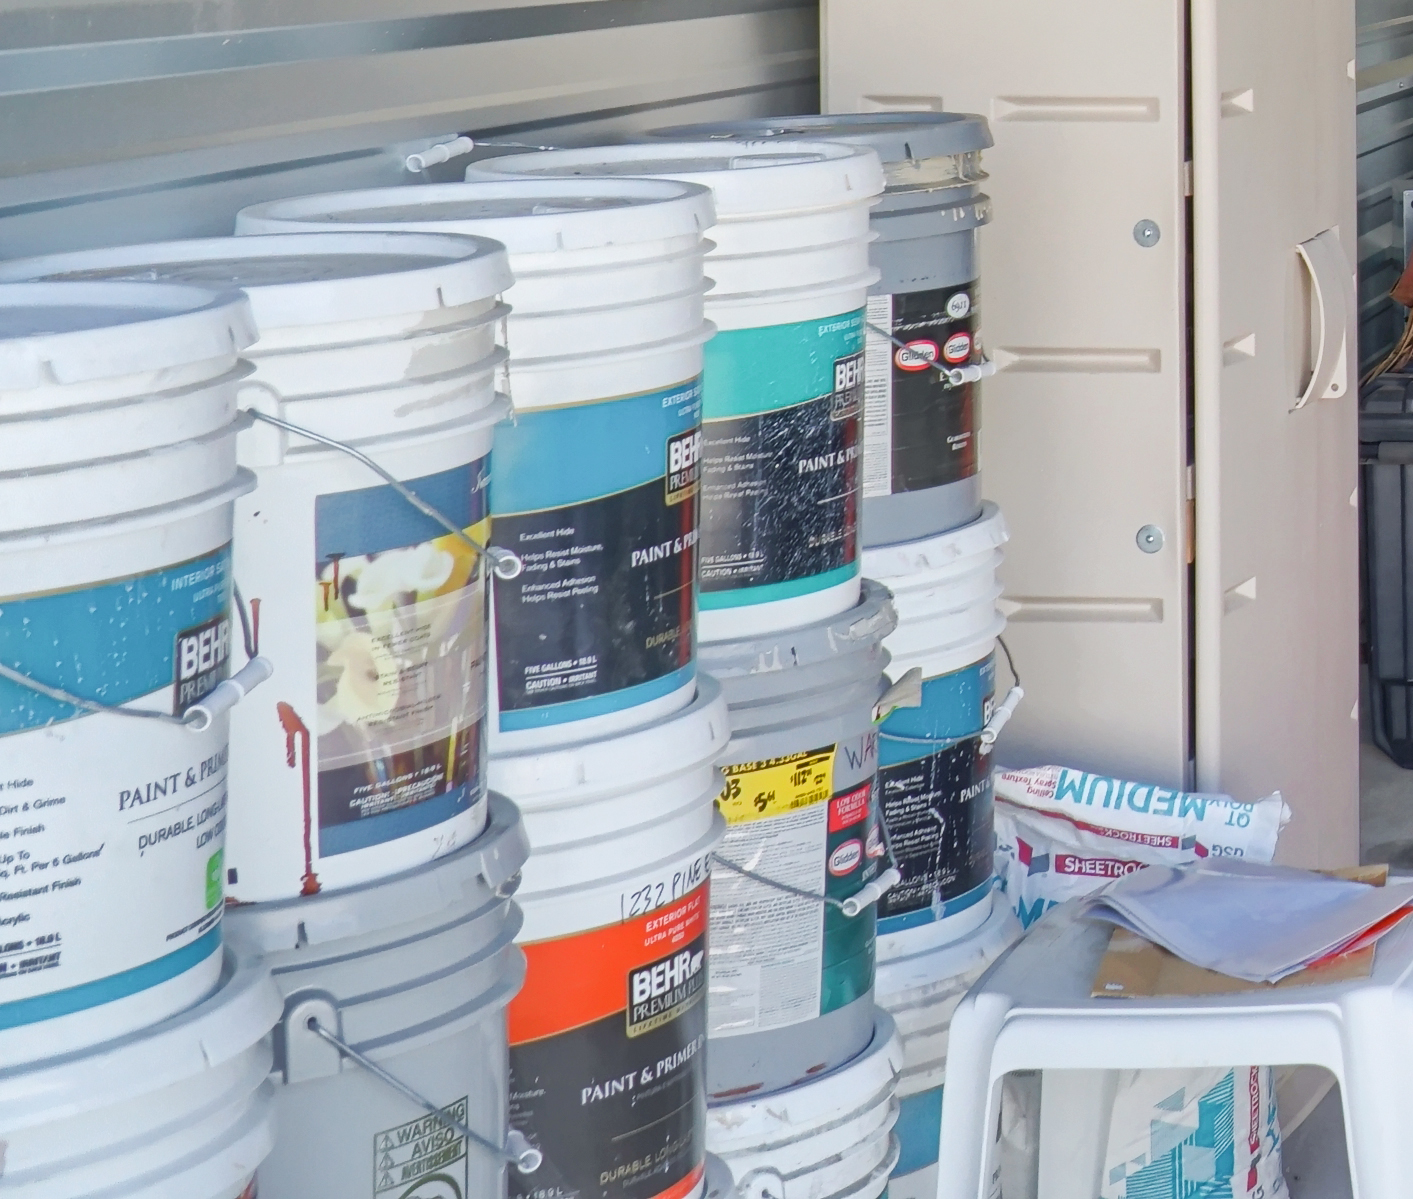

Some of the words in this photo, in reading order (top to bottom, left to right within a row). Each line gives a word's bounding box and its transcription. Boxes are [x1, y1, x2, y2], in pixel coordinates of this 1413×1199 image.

[818, 321, 850, 337] EXTERIOR
[901, 349, 934, 362] Glidden
[948, 340, 969, 355] Glidden
[662, 389, 694, 408] EXTERIOR
[798, 452, 835, 474] PAINT
[836, 450, 844, 464] &
[520, 531, 555, 542] Excellent
[556, 527, 575, 537] Hide
[520, 552, 544, 563] Helps
[545, 548, 569, 559] Resist
[630, 542, 672, 568] PAINT
[673, 538, 683, 554] &
[549, 560, 556, 569] &
[557, 557, 581, 568] Stains
[171, 563, 216, 592] INTERIOR
[701, 568, 732, 578] CAUTION
[521, 582, 561, 594] Enhanced
[521, 593, 545, 604] Helps
[645, 625, 681, 649] DURABLE
[524, 665, 540, 675] FIVE
[541, 659, 573, 673] GALLONS
[525, 676, 562, 690] CAUTION
[732, 759, 757, 774] BASE
[7, 778, 34, 790] Hide
[353, 782, 374, 795] FIVE
[376, 772, 414, 788] GALLONS
[1001, 772, 1032, 786] Texture
[1034, 777, 1057, 789] Spray
[118, 772, 182, 812] PAINT
[184, 767, 197, 788] &
[959, 780, 986, 804] PAINT
[1026, 786, 1055, 799] Ceiling
[1053, 768, 1213, 822] MEDIUM
[0, 804, 18, 816] Dirt
[22, 802, 30, 812] &
[33, 796, 66, 810] Grime
[836, 795, 851, 809] LOW
[1224, 811, 1251, 829] QT
[13, 823, 45, 838] Finish
[138, 815, 194, 851] DURABLE
[196, 827, 214, 850] LOW
[1103, 828, 1173, 848] SHEETROCK
[18, 850, 31, 861] To
[833, 848, 860, 867] Glidden
[31, 861, 49, 873] Per
[621, 882, 666, 926] 1232
[672, 857, 702, 903] PINE
[645, 906, 687, 933] EXTERIOR
[644, 930, 667, 947] ULTRA
[667, 921, 685, 936] PURE
[632, 950, 691, 1006] BEHR
[633, 983, 687, 1024] PREMIUM
[581, 1070, 638, 1106] PAINT
[640, 1065, 654, 1085] &
[656, 1038, 697, 1079] PRIMER
[396, 1102, 465, 1144] WARNNG
[411, 1127, 455, 1160] AVISO
[600, 1154, 652, 1186] DURABLE
